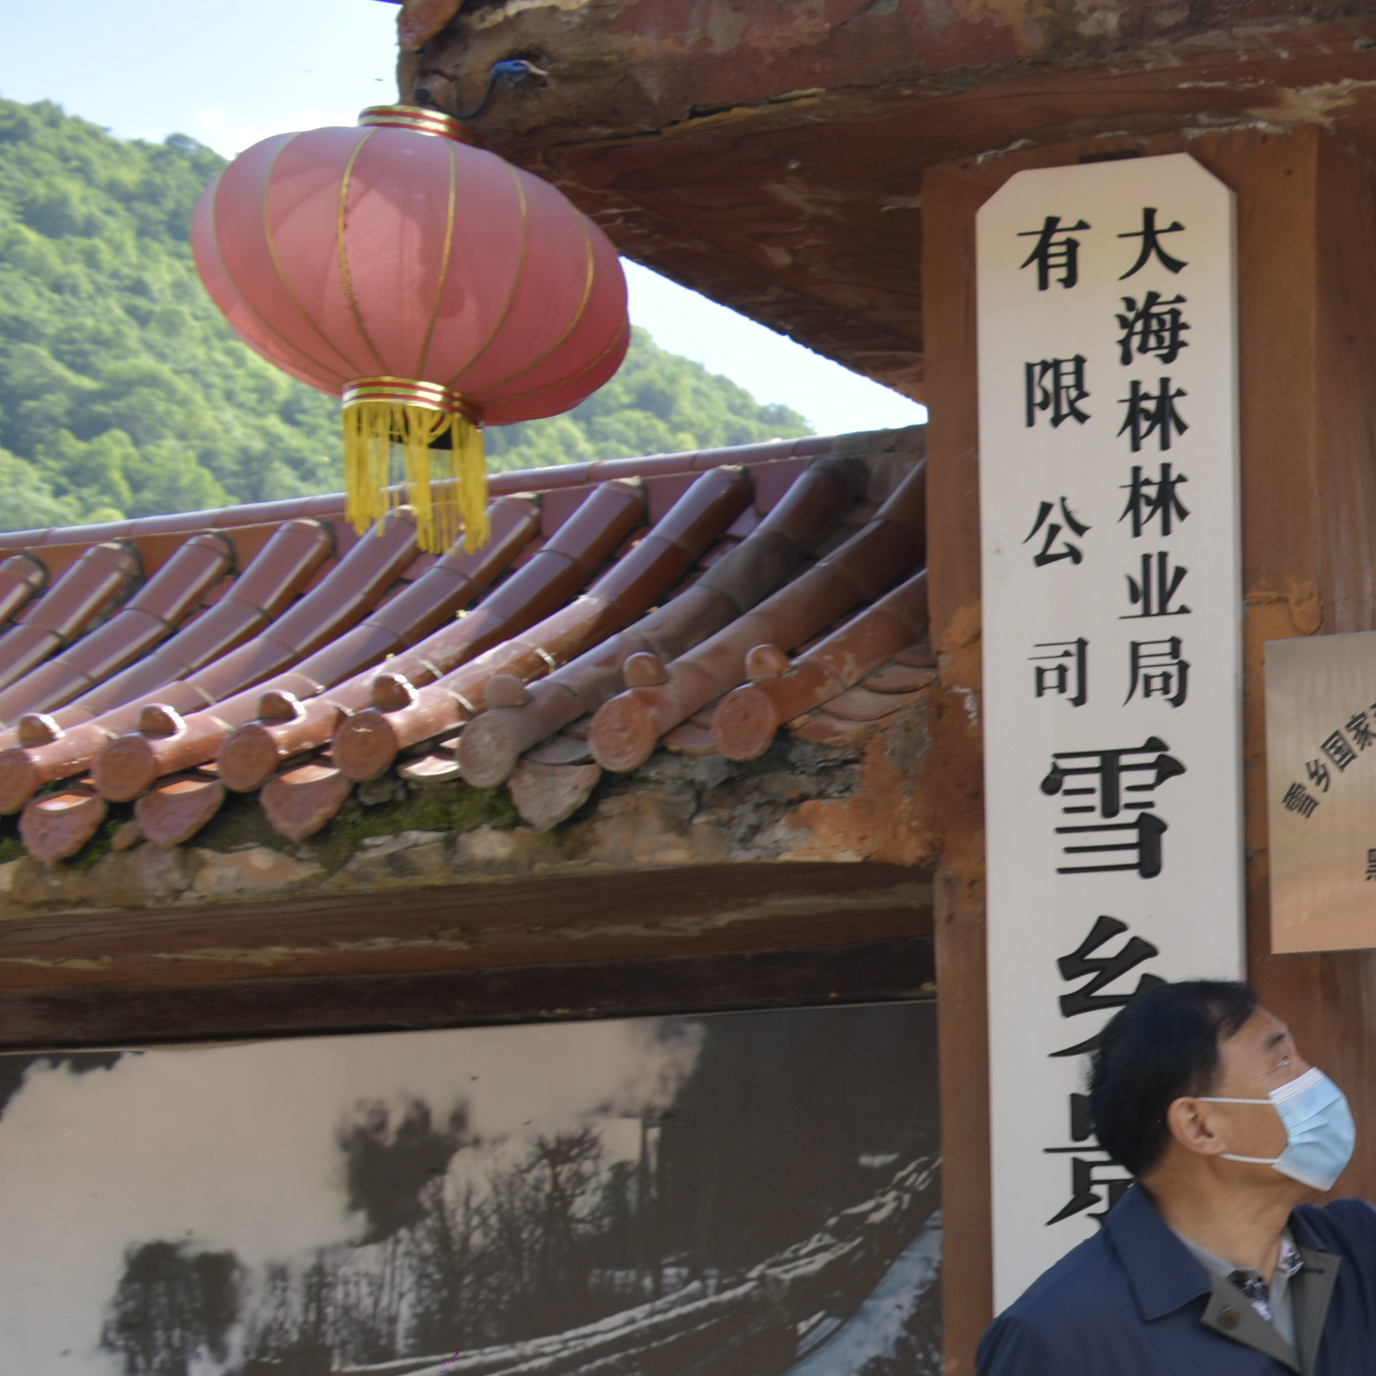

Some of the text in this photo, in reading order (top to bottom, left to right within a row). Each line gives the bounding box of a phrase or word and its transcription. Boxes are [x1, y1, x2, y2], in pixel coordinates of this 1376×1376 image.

[1016, 215, 1092, 708] 有限公司
[1114, 206, 1192, 708] 大海林林业局
